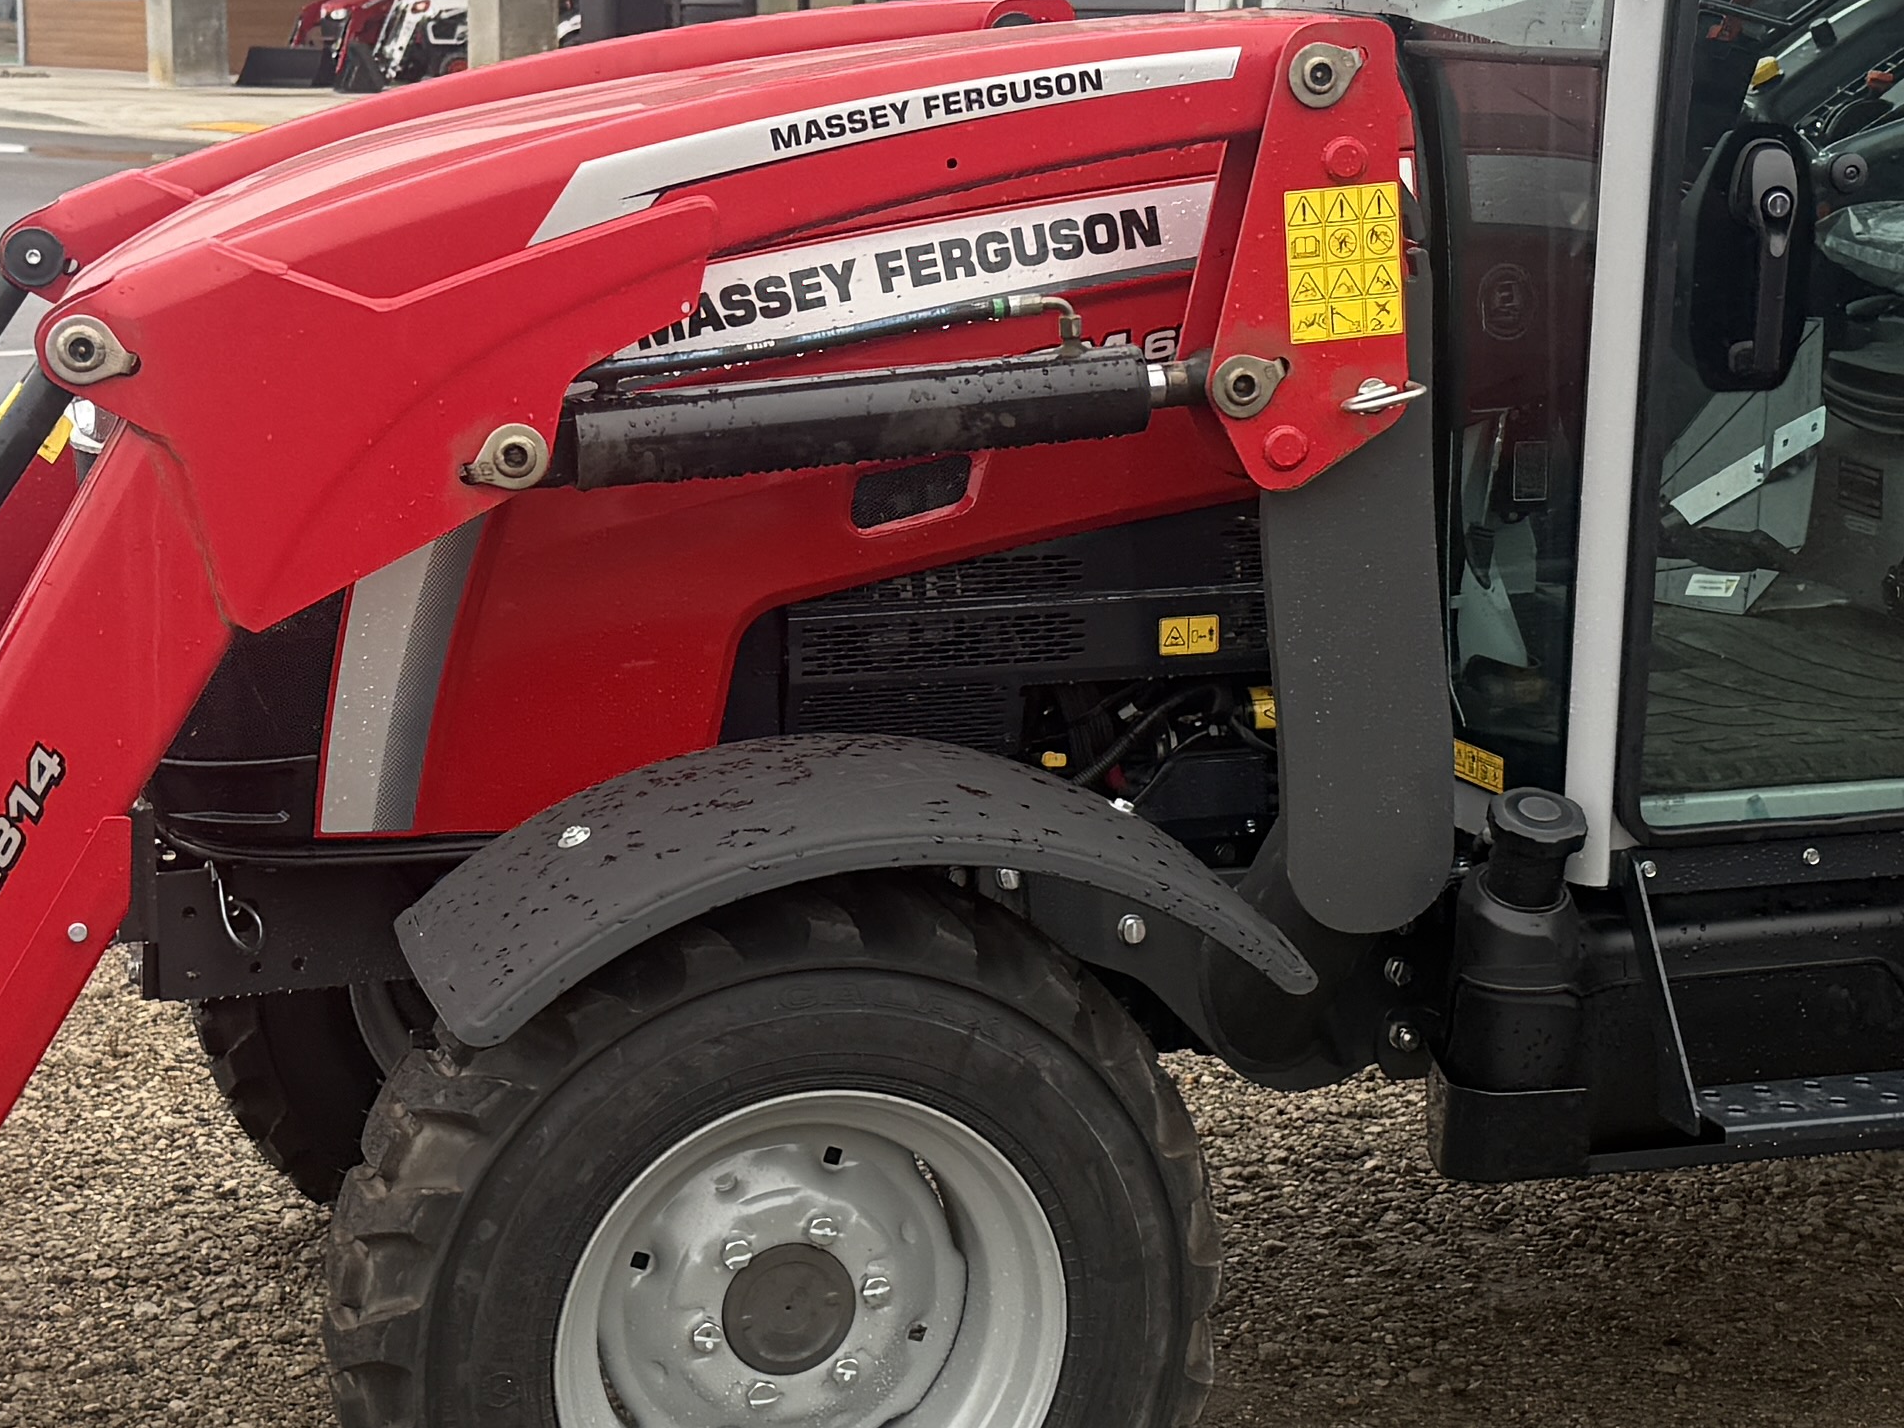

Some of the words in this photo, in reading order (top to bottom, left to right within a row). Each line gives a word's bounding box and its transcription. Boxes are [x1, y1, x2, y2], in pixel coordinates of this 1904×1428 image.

[770, 99, 910, 152] MASSEY
[922, 68, 1104, 119] FERGUSON
[874, 205, 1163, 293] FERGUSON
